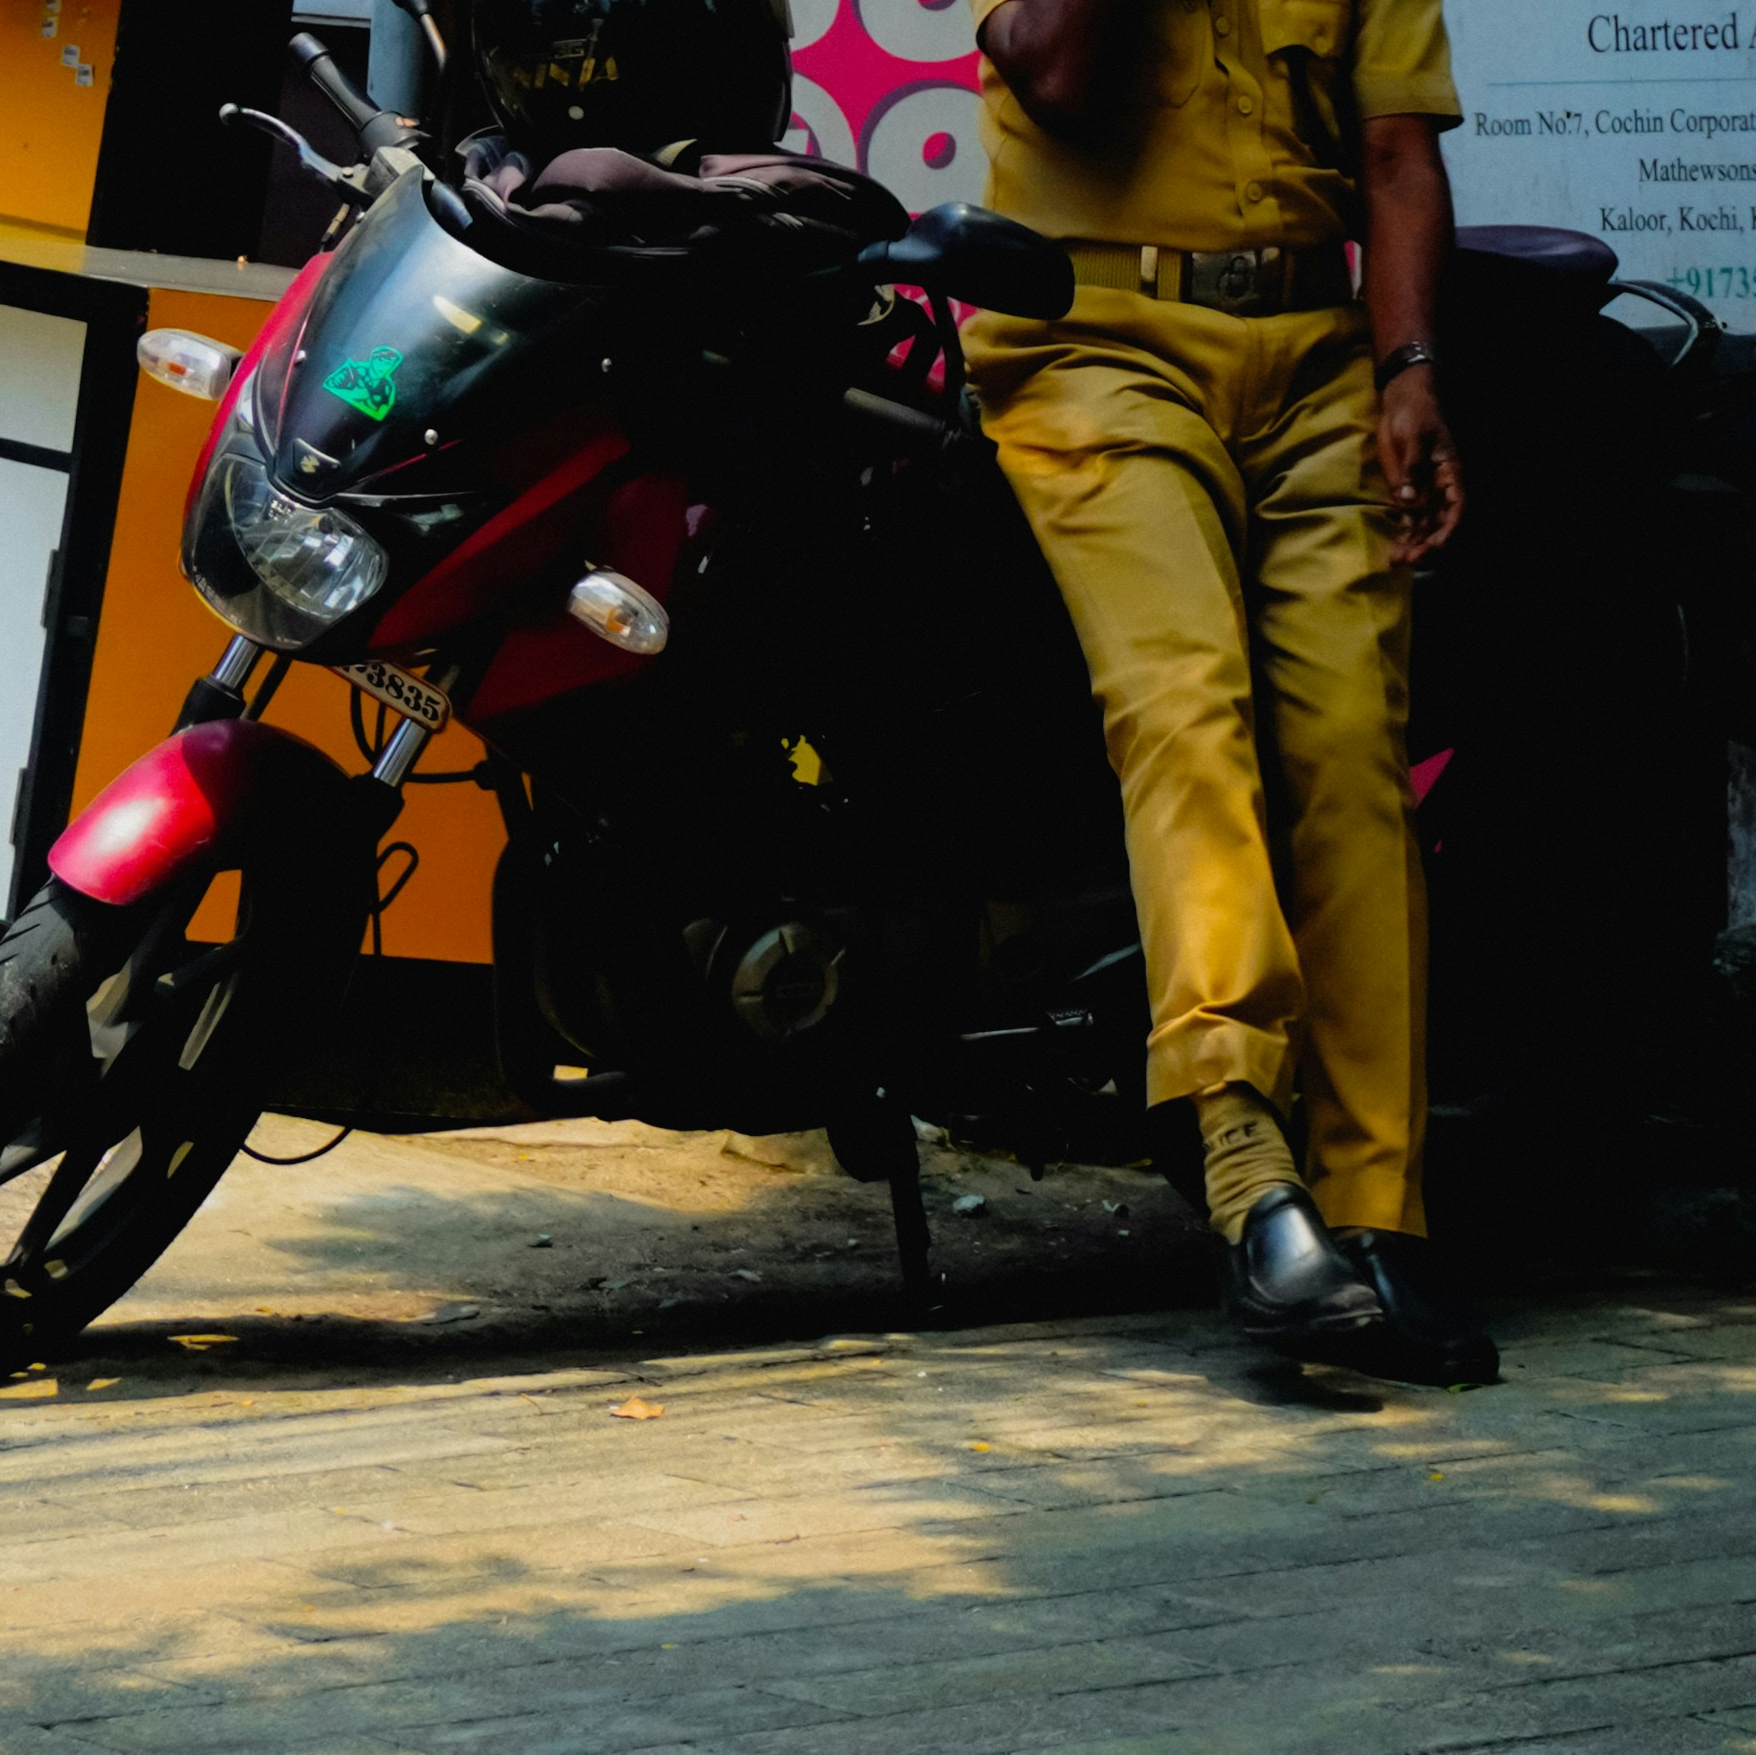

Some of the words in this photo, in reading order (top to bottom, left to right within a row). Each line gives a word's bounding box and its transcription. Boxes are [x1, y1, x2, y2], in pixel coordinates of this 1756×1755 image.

[1586, 10, 1740, 55] Chartered
[1474, 110, 1533, 137] Room
[1594, 106, 1665, 136] Cochin
[1599, 205, 1674, 237] Kaloor,
[1678, 205, 1745, 236] Kochi,
